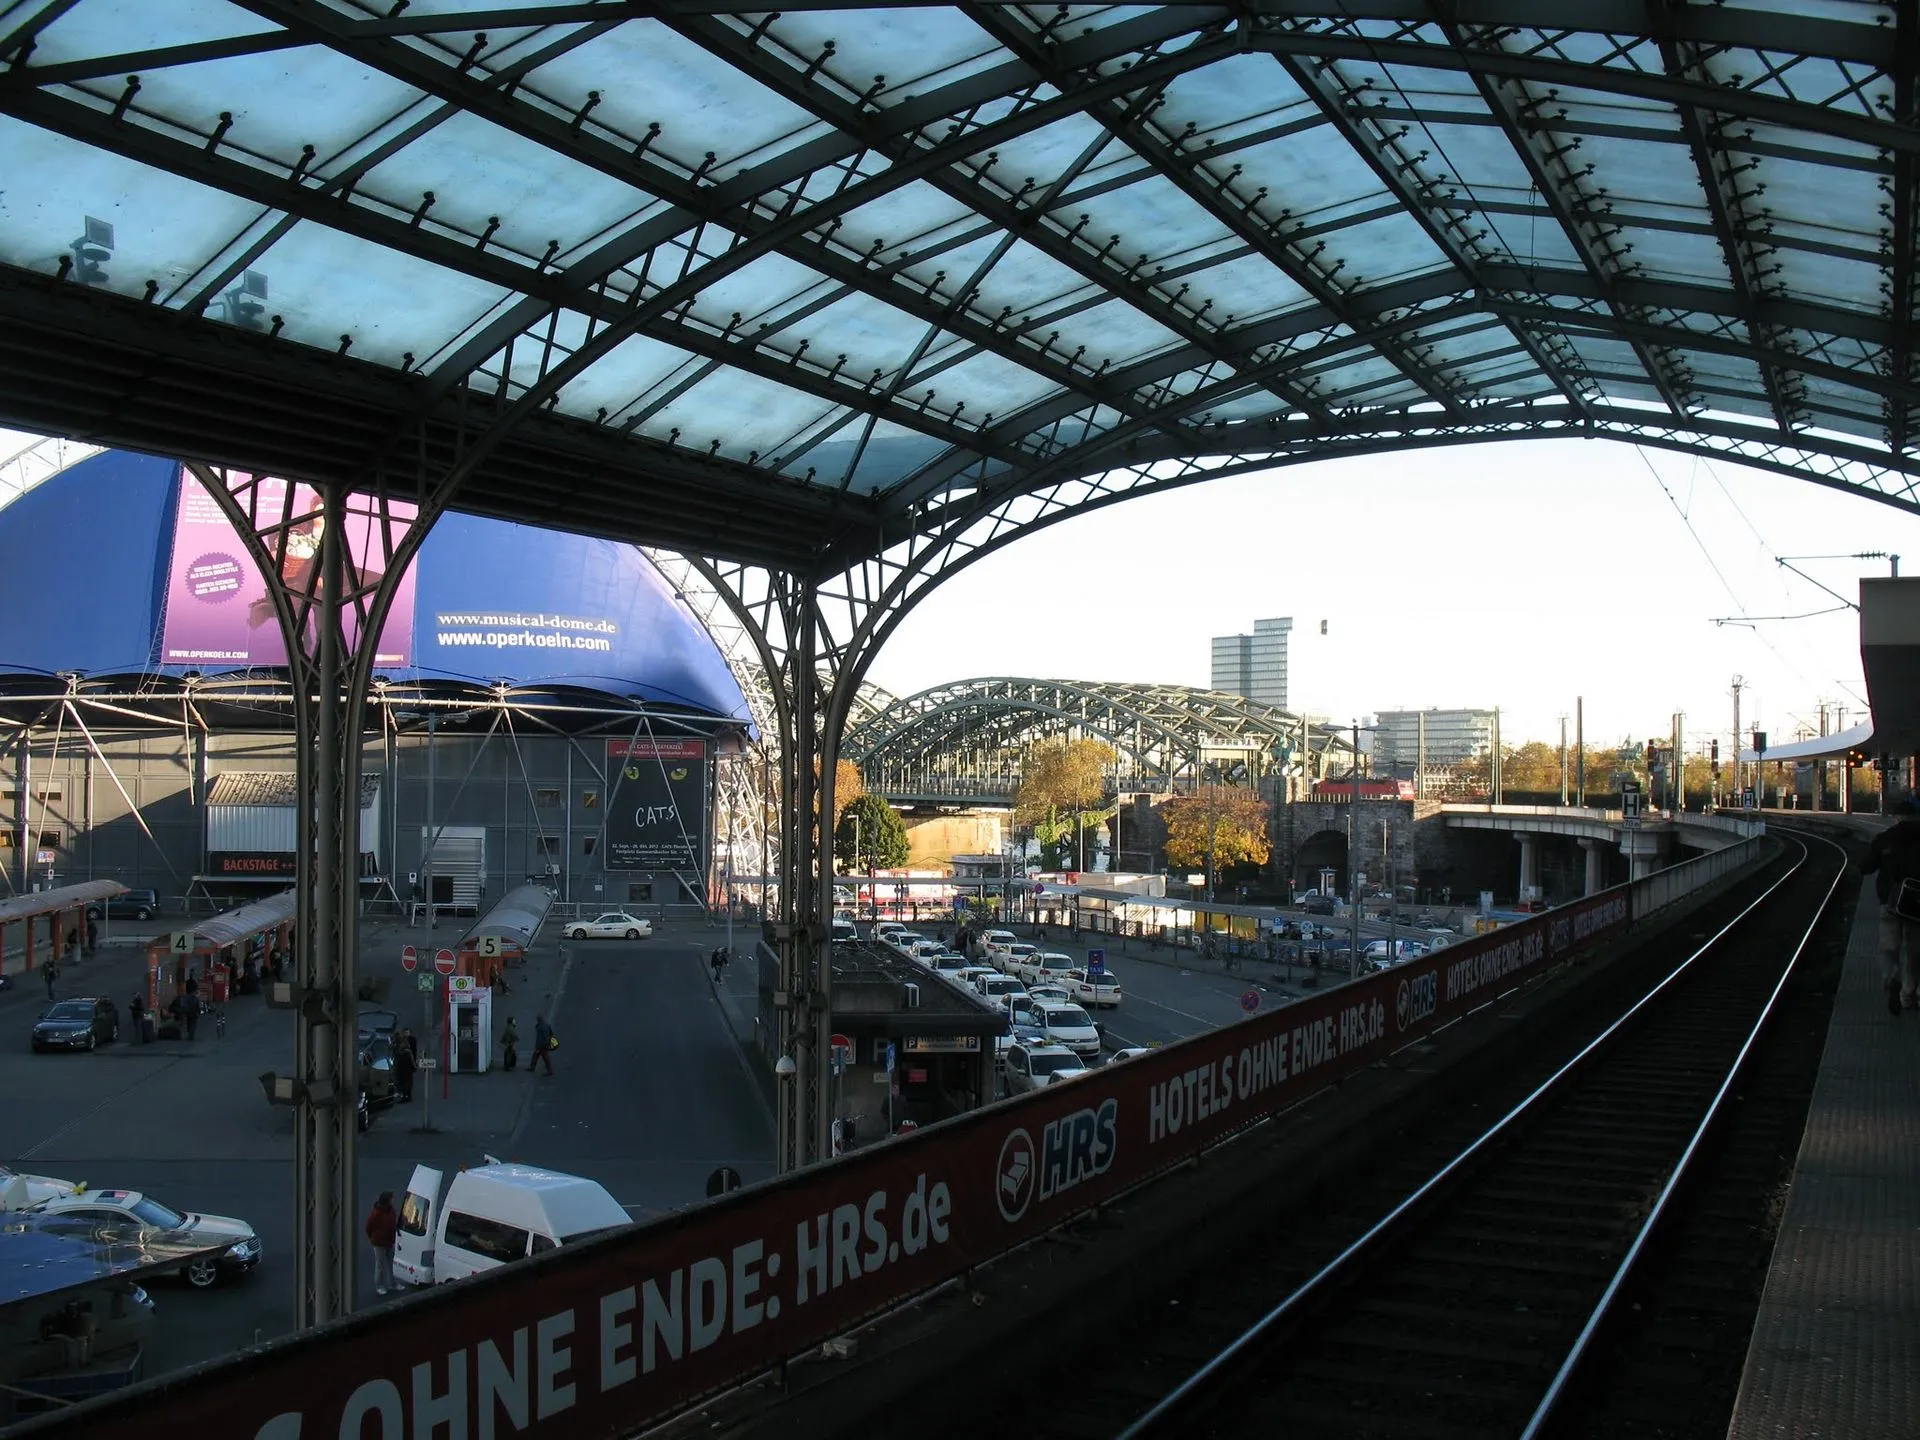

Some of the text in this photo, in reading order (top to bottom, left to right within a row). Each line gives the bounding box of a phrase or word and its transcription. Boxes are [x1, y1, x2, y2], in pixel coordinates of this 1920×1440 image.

[438, 614, 616, 634] www.musical-dome.de
[438, 631, 610, 651] www.operkoeln.com
[169, 650, 249, 659] WWW.OPERKOELN.COM
[1624, 795, 1637, 816] H
[635, 805, 675, 828] CATS
[224, 858, 279, 871] BACKSTAGE
[175, 935, 187, 950] 4
[485, 938, 495, 954] 5
[1149, 997, 1385, 1144] HOTELS OHNE ENDE: HRS.de
[338, 1098, 1119, 1440] OHNE ENDE: HRS.de HRS
